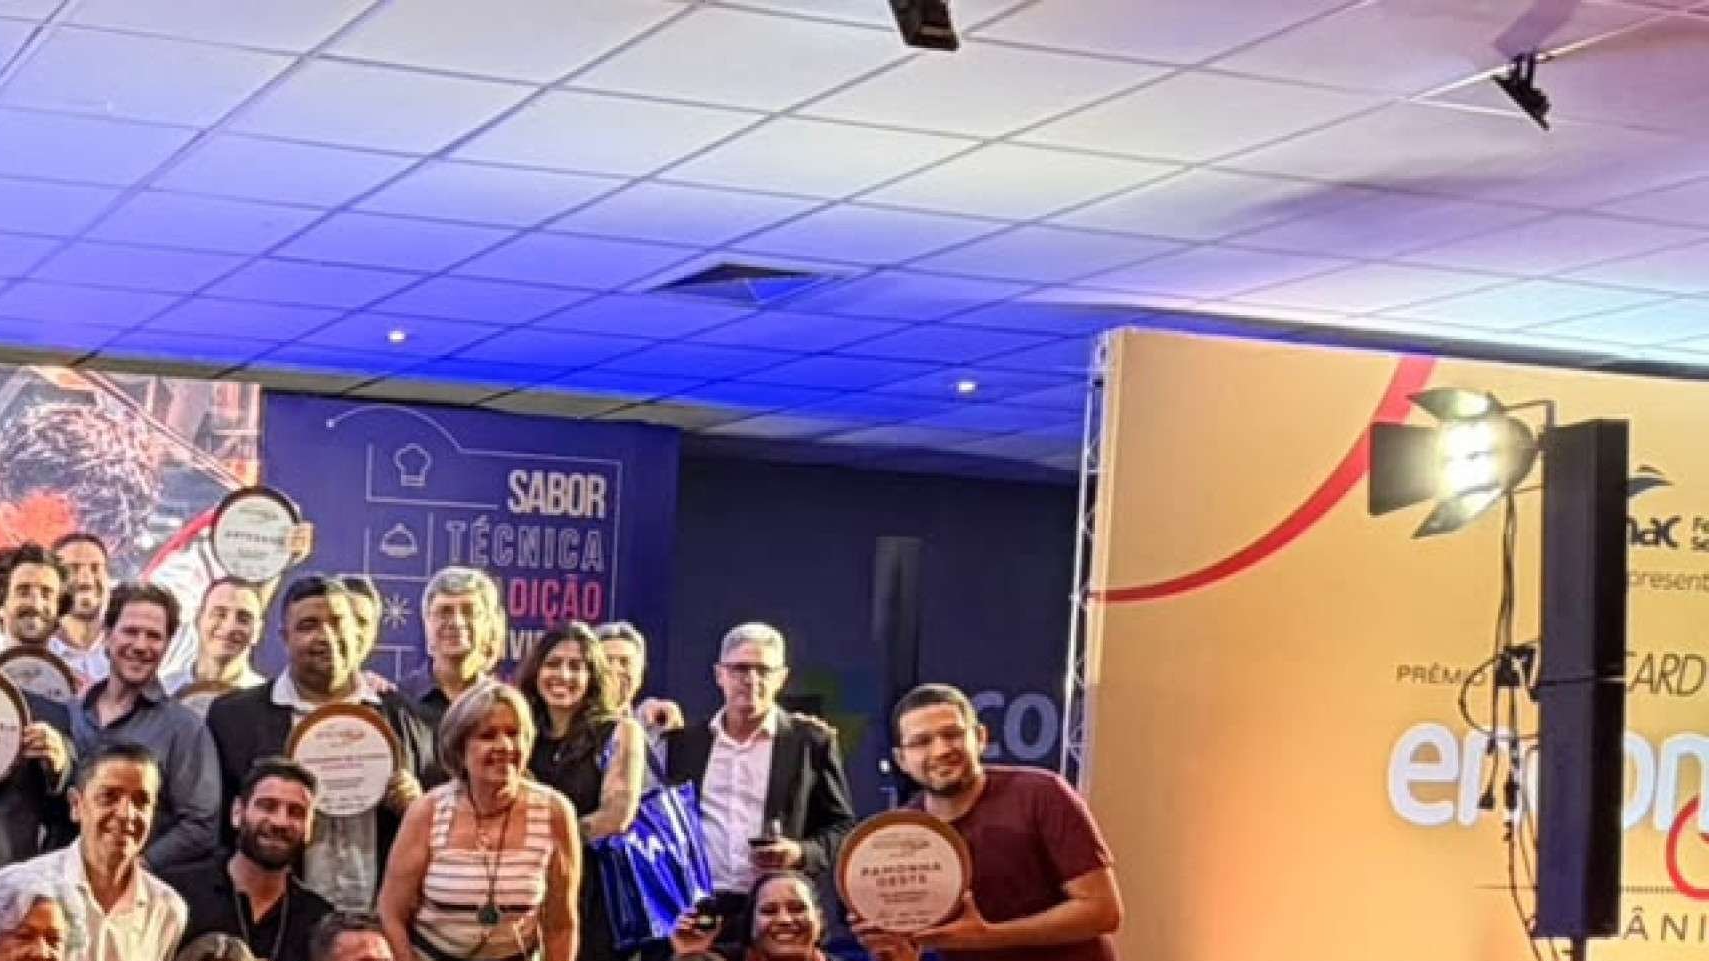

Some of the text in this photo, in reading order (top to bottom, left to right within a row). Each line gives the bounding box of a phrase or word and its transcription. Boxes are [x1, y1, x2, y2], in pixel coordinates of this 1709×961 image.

[508, 469, 606, 518] SABOR
[446, 514, 605, 572] TÉCNICA
[508, 573, 604, 630] DIÇÃO
